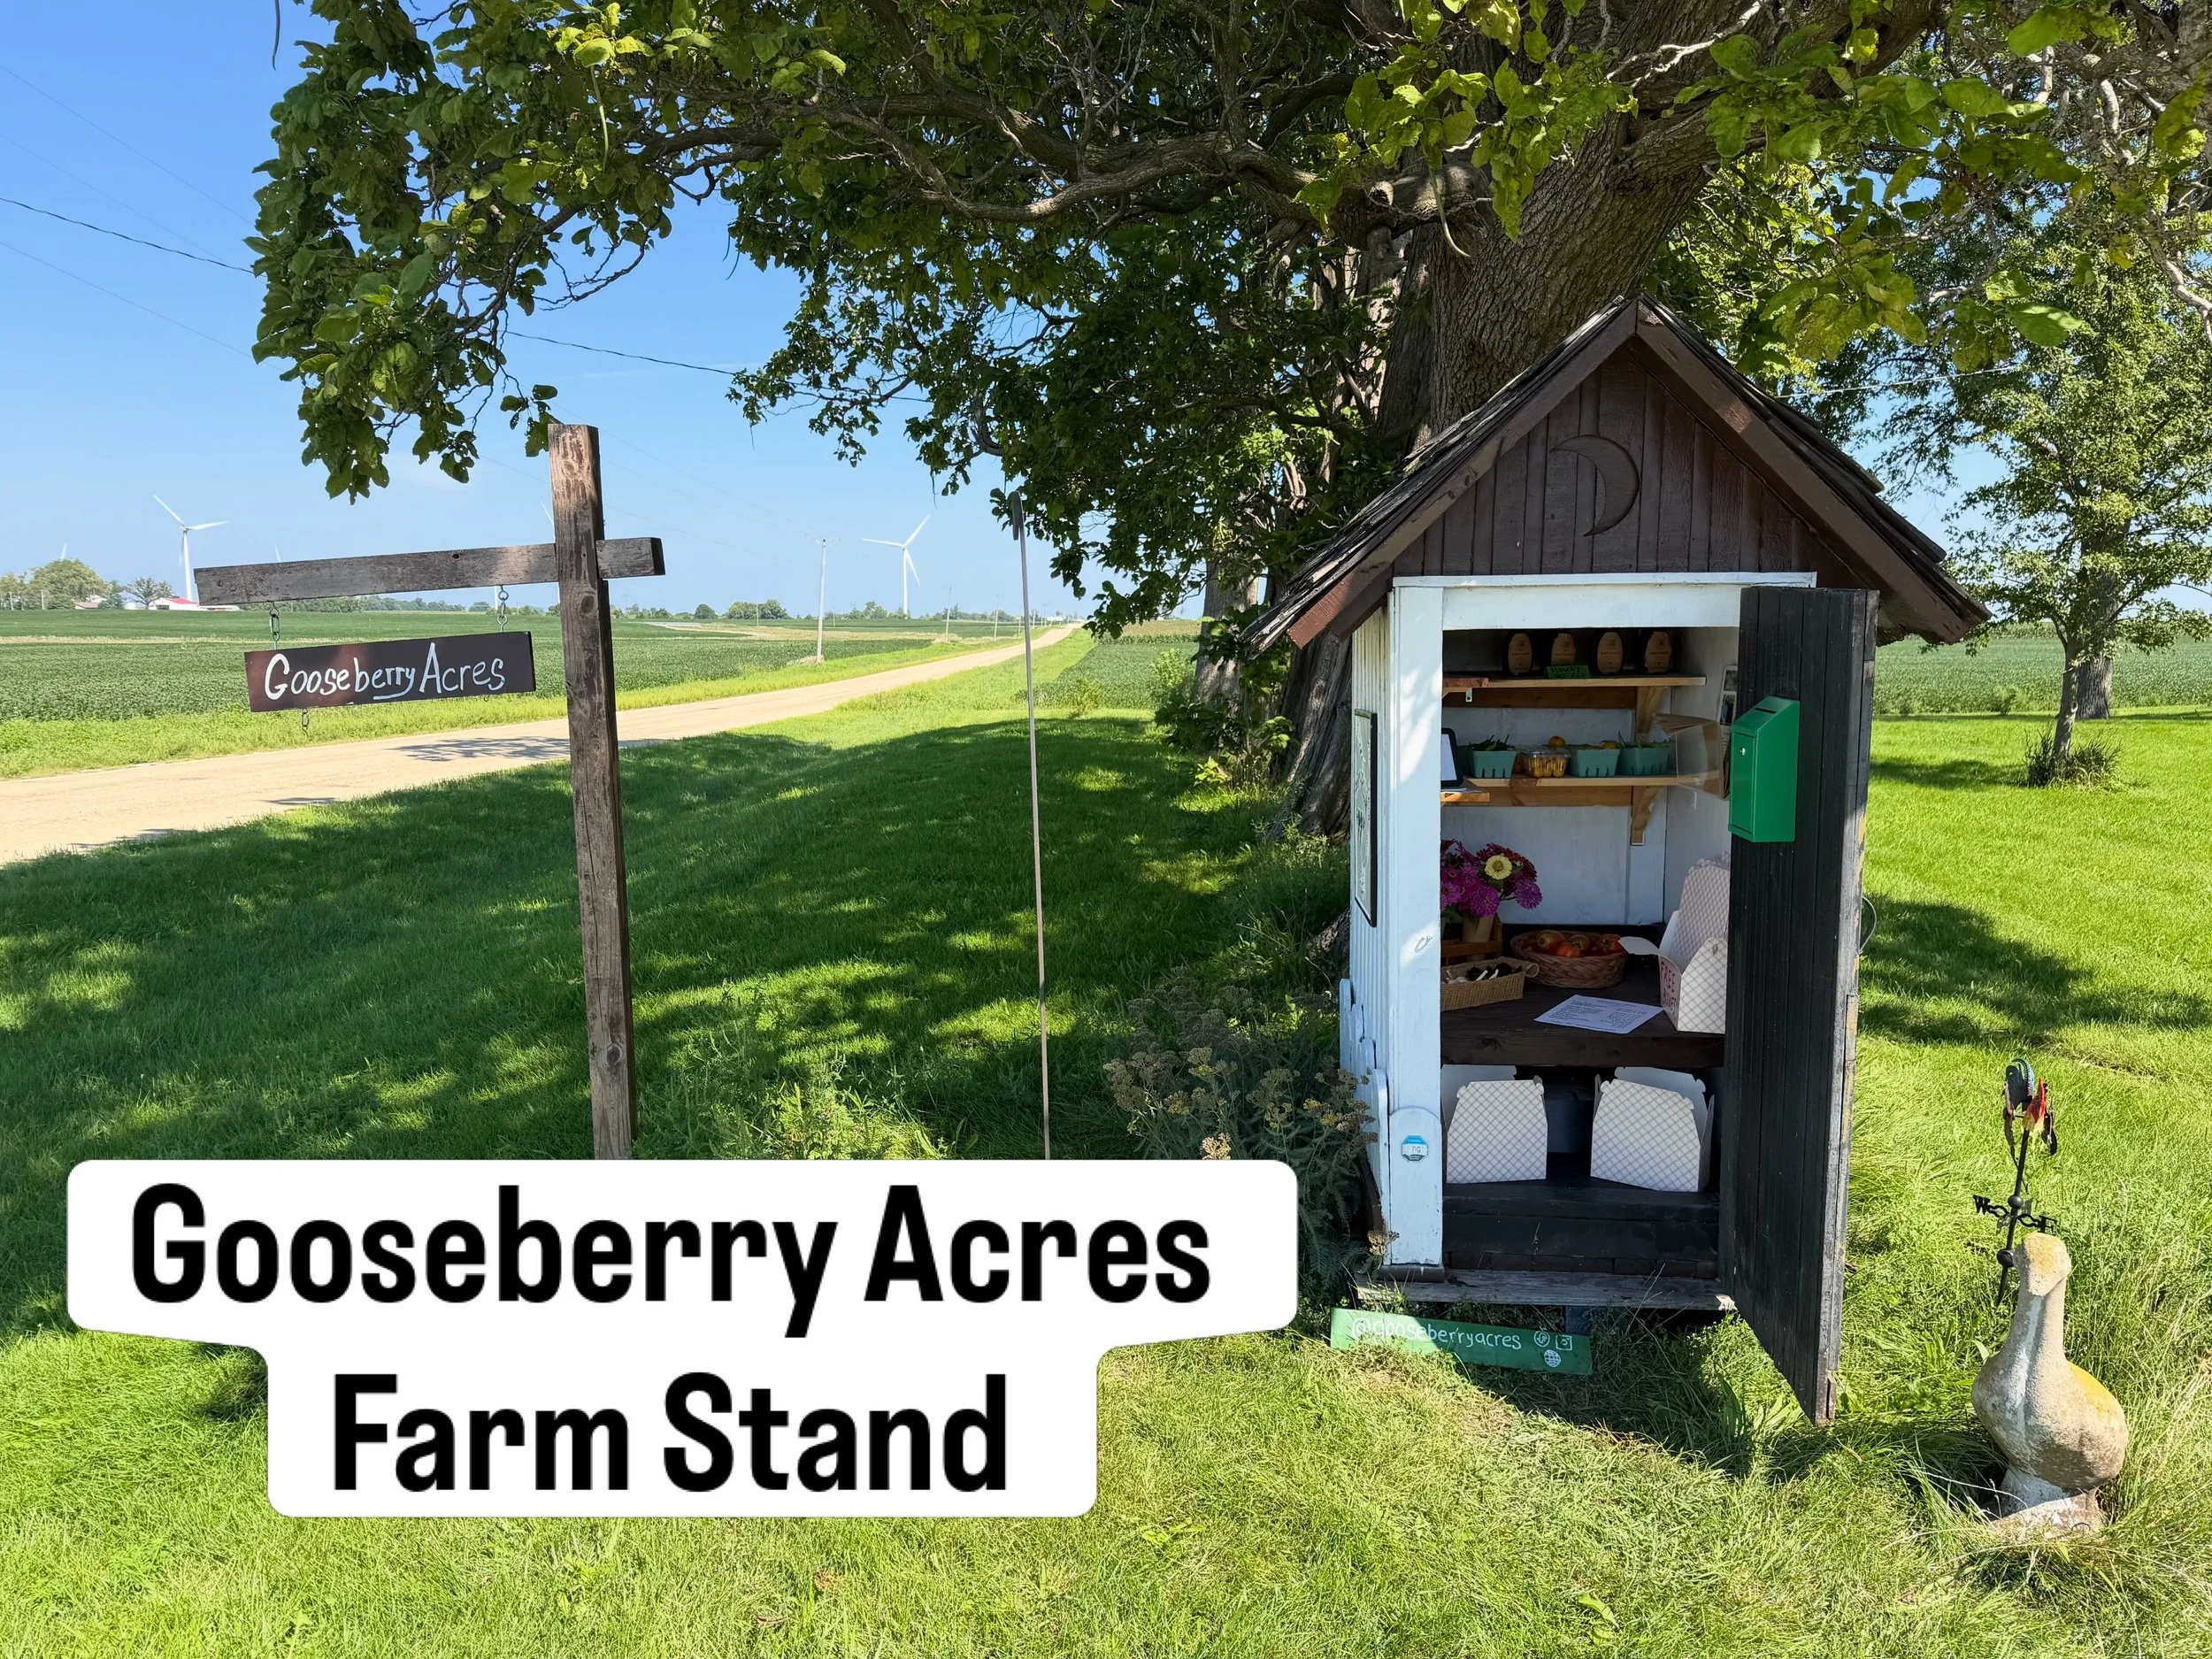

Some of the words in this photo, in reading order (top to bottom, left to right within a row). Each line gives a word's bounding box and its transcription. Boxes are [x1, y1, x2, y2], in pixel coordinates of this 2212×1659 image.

[265, 653, 416, 701] Gooseberry
[419, 641, 505, 694] Acres
[1352, 1317, 1523, 1350] @gooseberryacres
